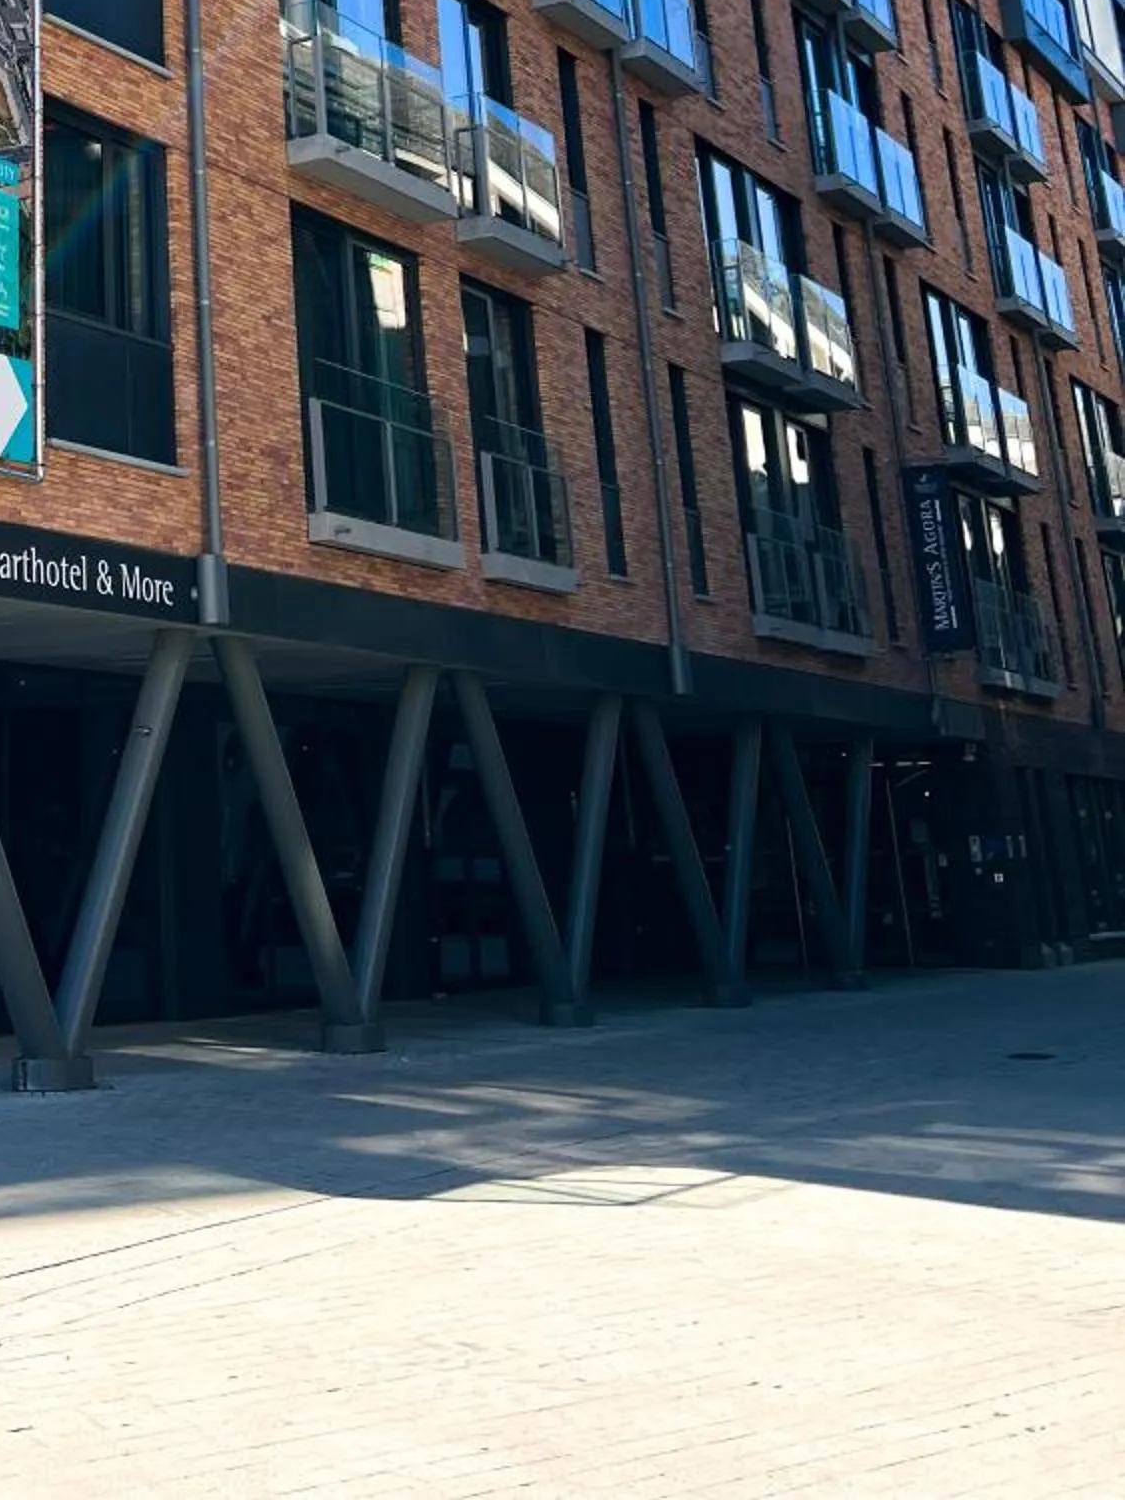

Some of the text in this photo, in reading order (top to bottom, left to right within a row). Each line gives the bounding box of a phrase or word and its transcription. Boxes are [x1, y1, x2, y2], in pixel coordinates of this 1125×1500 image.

[919, 499, 940, 555] AGORA
[96, 558, 114, 596] &
[119, 562, 174, 607] More
[926, 561, 950, 631] MARTIN'S
